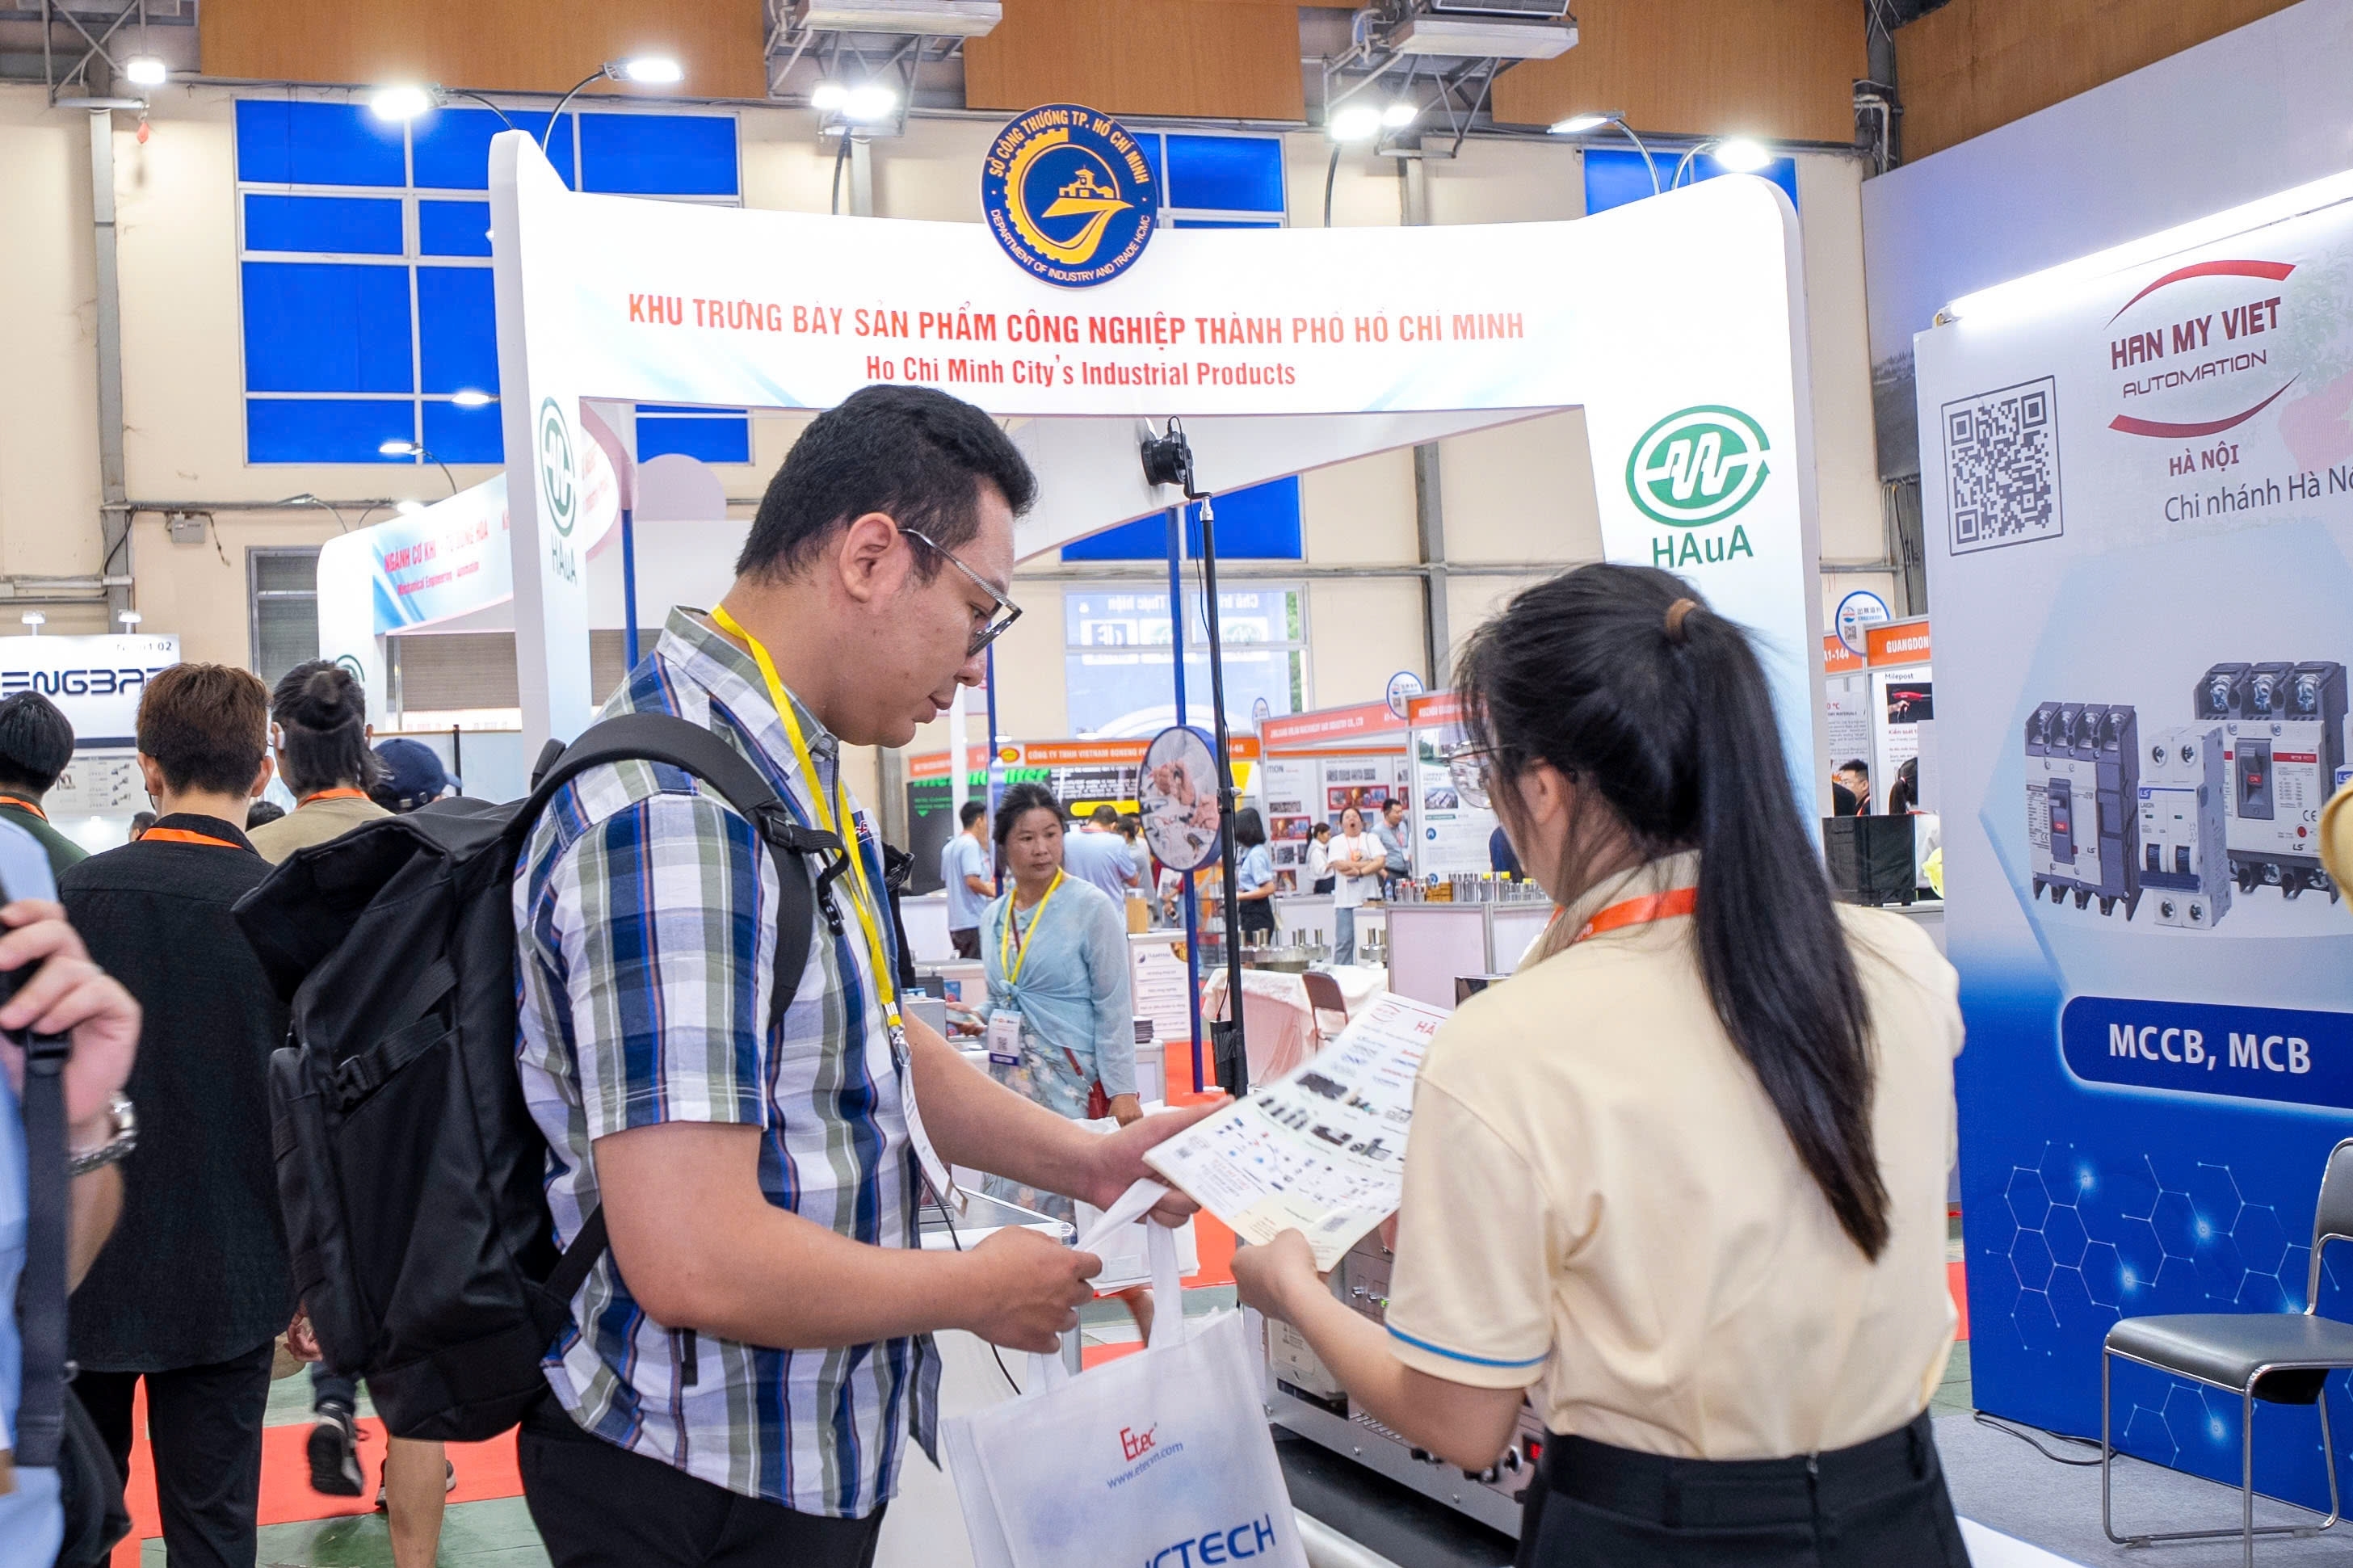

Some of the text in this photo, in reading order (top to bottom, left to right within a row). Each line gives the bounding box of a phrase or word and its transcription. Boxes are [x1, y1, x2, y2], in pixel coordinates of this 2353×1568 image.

[996, 128, 1026, 159] CÔNG
[1020, 109, 1069, 135] THƯƠNG
[1072, 111, 1090, 128] TP.
[1110, 131, 1134, 153] CHÍ
[1125, 152, 1150, 184] MINH
[990, 209, 1151, 282] DEPARTMENT OF INDUSTRY AND TRADE HCMC
[629, 293, 683, 326] KHU
[793, 300, 842, 334] BÀY
[855, 299, 909, 338] SẢN
[919, 301, 997, 341] PHẨM
[1006, 309, 1079, 343] CÔNG
[1088, 311, 1185, 351] NGHIỆP
[1195, 312, 1283, 344] THÀNH
[1452, 313, 1523, 340] MINH
[2111, 296, 2281, 370] HAN MY VIET
[867, 354, 1296, 388] Ho Chi Minh City's Industrial Products
[2123, 349, 2267, 399] AUTOMATION
[2170, 440, 2239, 477] HÀ NỘI
[2165, 465, 2353, 522] Chi nhánh Hà N
[551, 532, 578, 587] HAuA
[1653, 524, 1754, 569] HAuA
[1886, 636, 1931, 654] GUANGDON
[1885, 671, 1914, 681] Milepost
[2108, 1023, 2312, 1074] MCCB, MCB
[1120, 1427, 1156, 1462] Etec
[1145, 1512, 1275, 1568] CTECH
